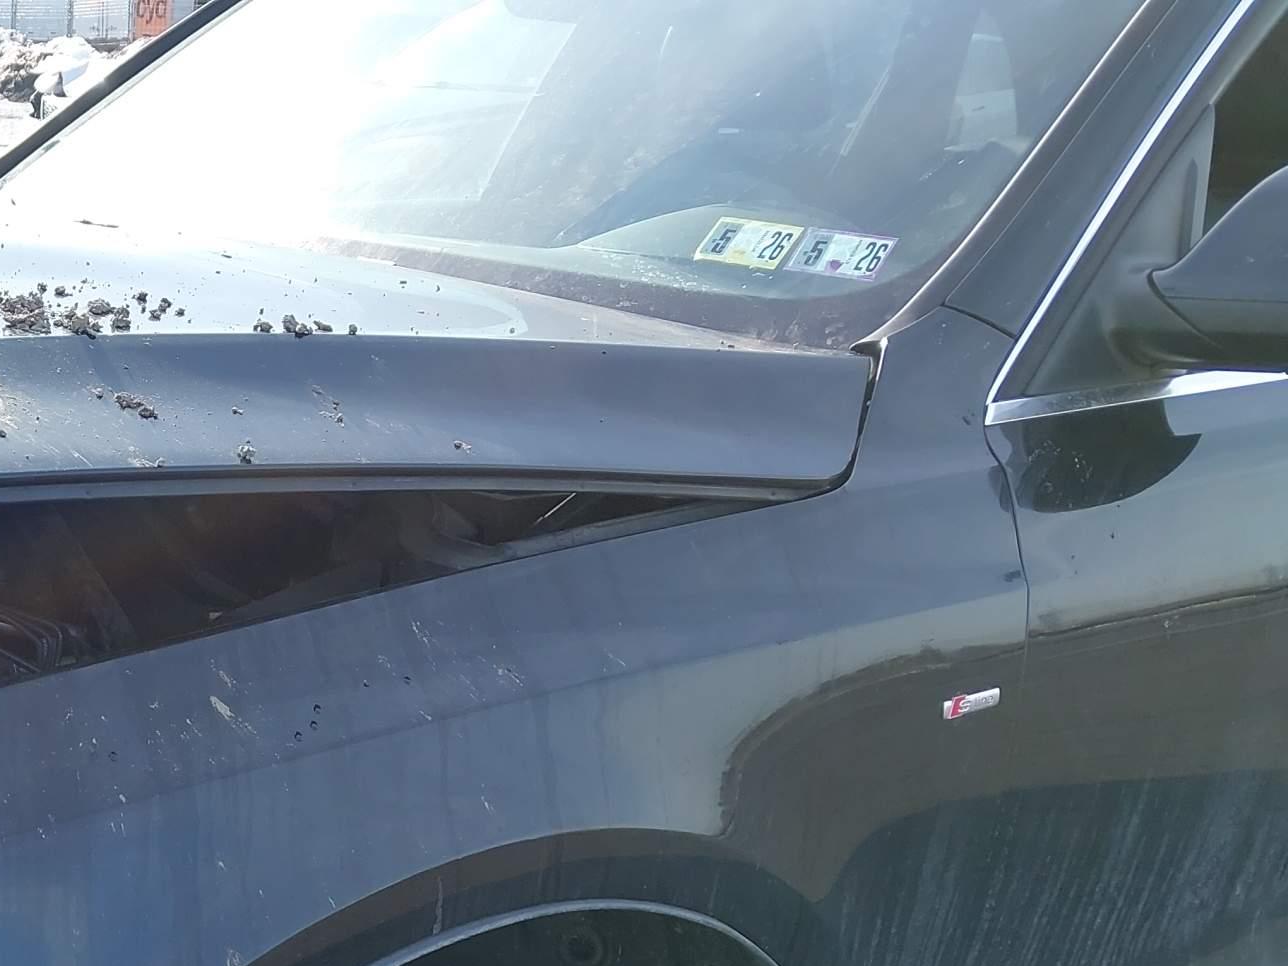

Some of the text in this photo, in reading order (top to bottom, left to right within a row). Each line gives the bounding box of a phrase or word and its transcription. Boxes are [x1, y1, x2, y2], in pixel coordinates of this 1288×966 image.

[757, 231, 793, 260] 26
[853, 242, 889, 272] 26
[958, 699, 971, 713] S
